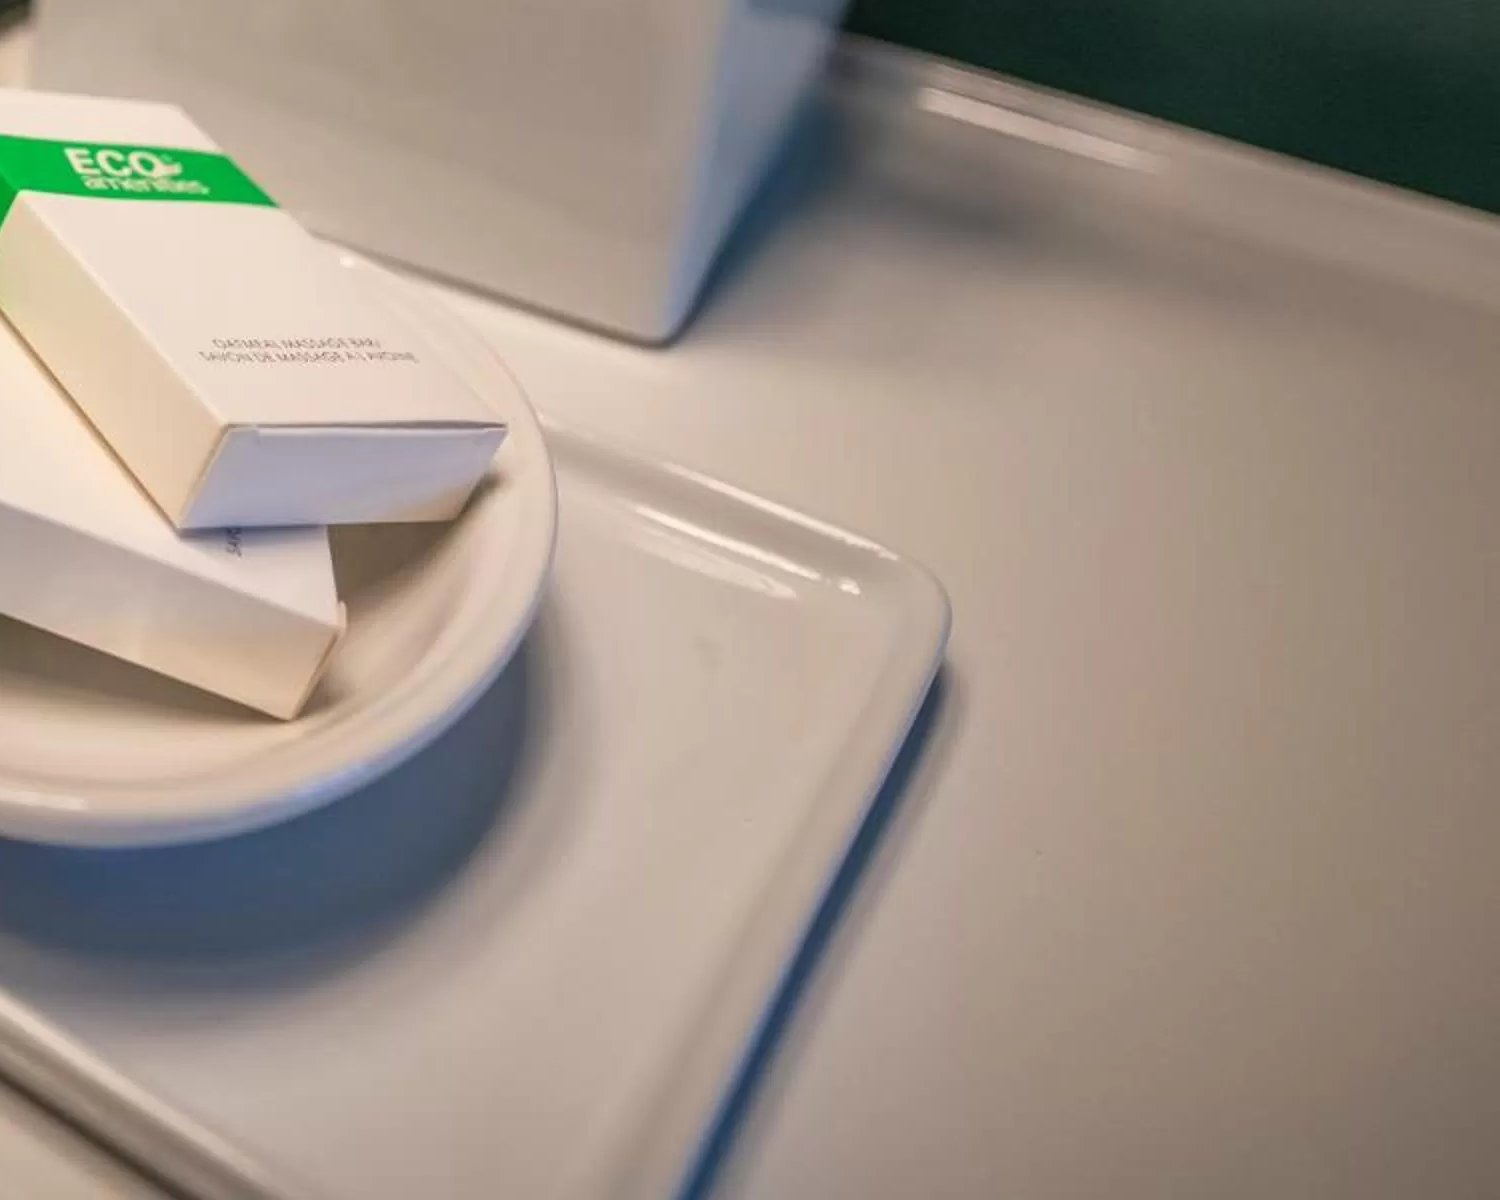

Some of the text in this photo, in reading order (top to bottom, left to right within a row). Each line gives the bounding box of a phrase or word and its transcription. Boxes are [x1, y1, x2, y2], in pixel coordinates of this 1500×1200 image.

[281, 337, 347, 349] MASSAGE
[198, 351, 252, 363] SAVON
[254, 351, 276, 363] DE
[277, 351, 344, 363] MASSAGE
